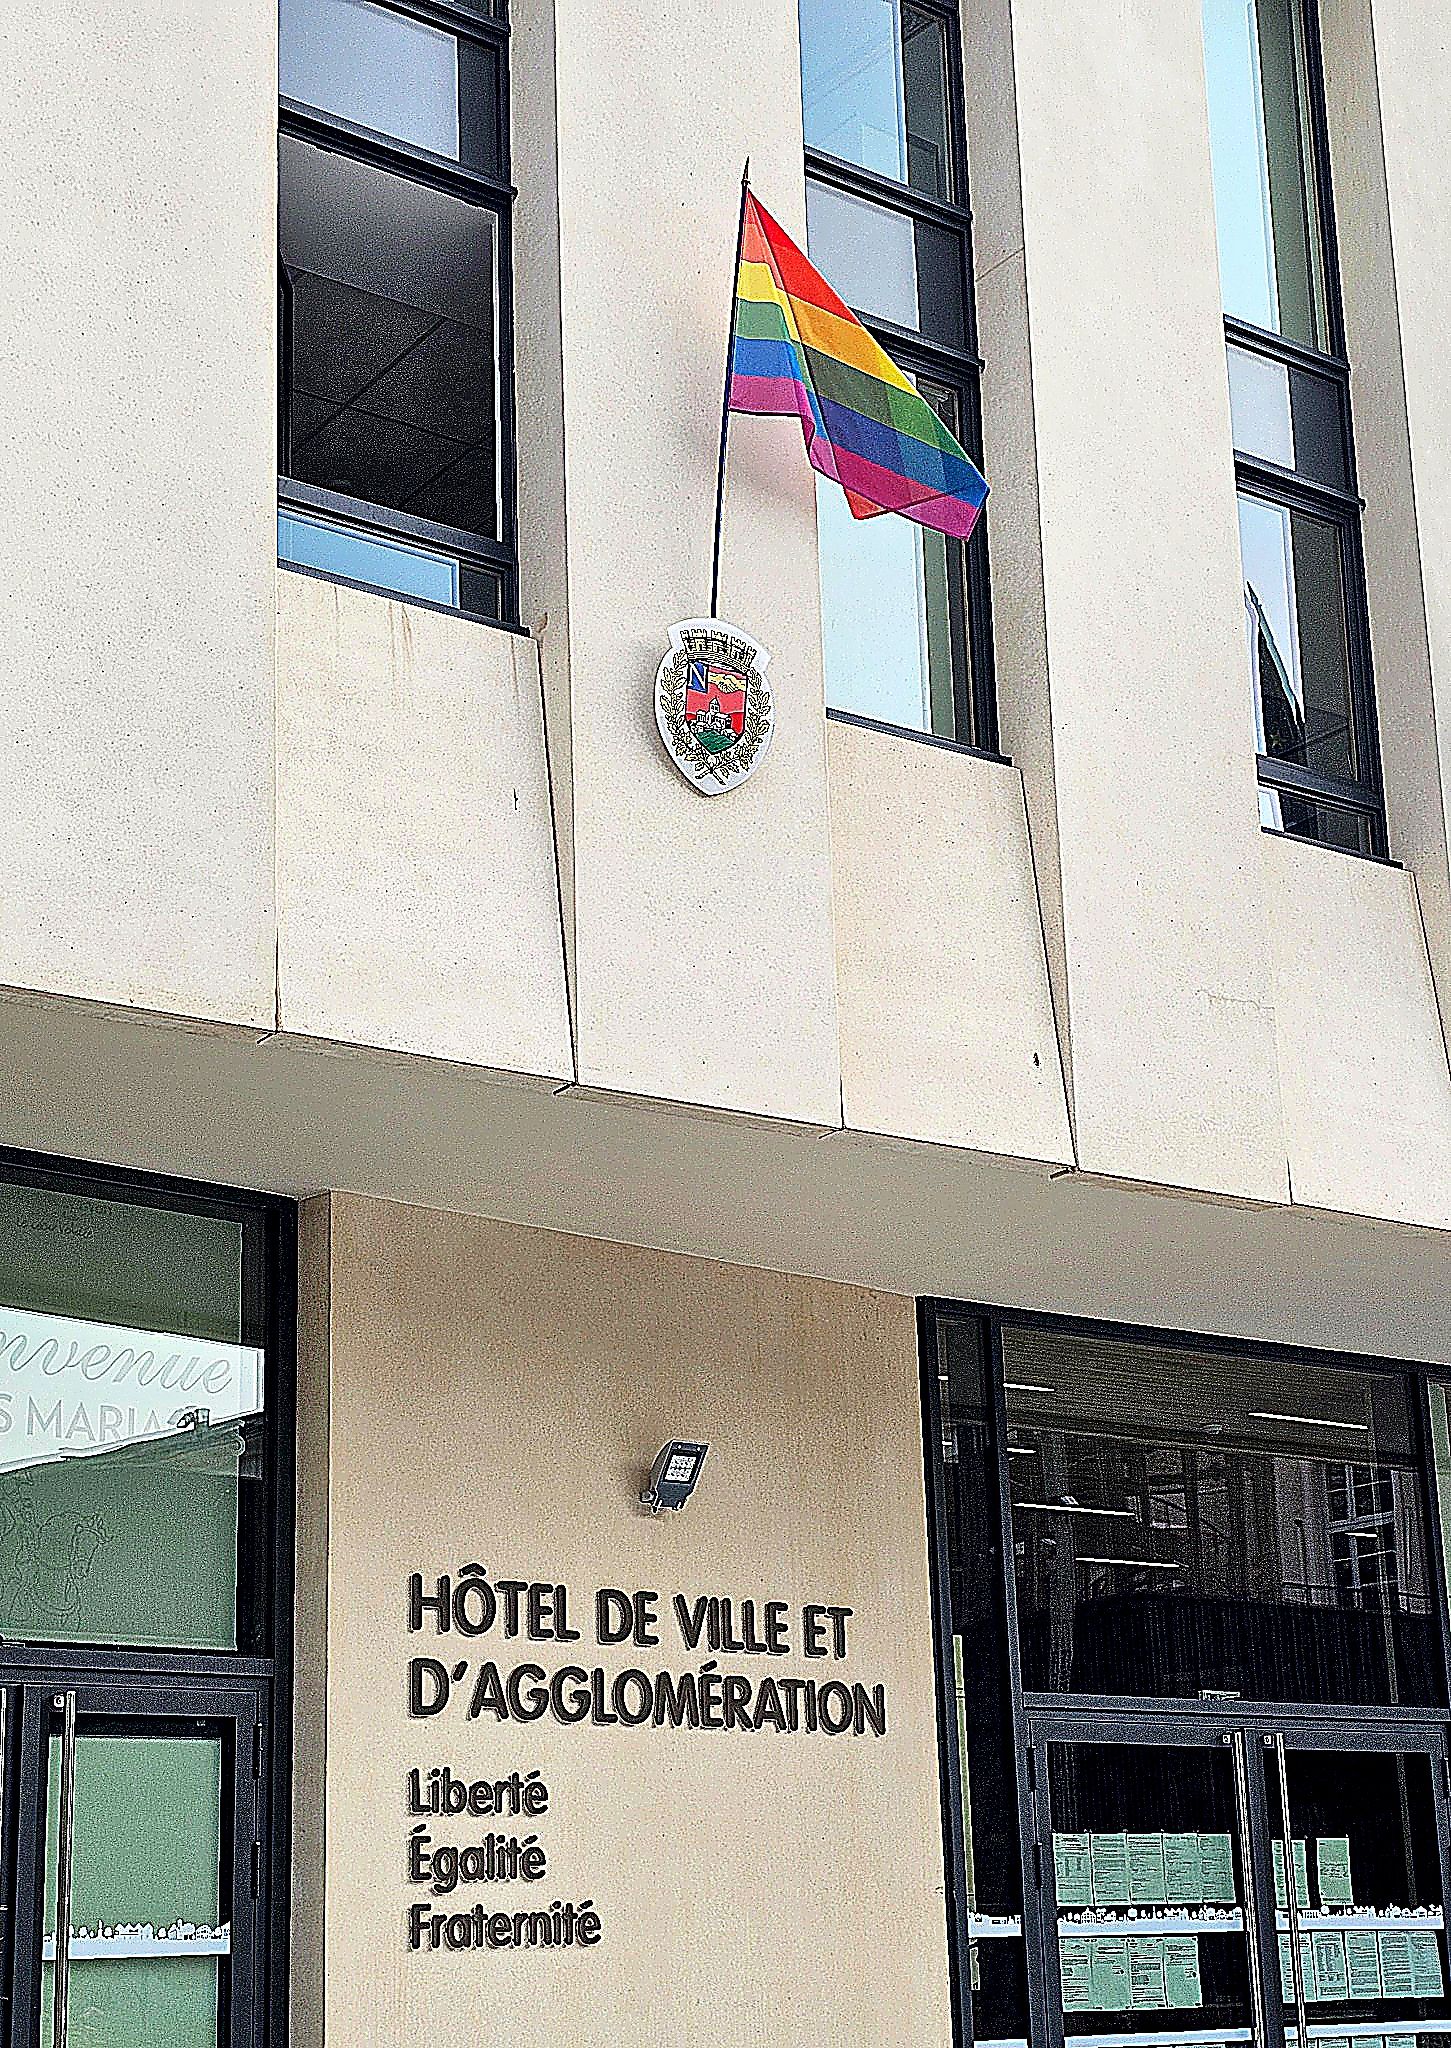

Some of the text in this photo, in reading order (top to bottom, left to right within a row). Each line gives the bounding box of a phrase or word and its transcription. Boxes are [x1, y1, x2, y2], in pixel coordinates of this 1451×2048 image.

[408, 1562, 854, 1659] HÔTEL DE VILLE ET
[407, 1766, 550, 1818] Liberté
[407, 1823, 547, 1895] Égalité
[407, 1899, 603, 1952] Fraternité
